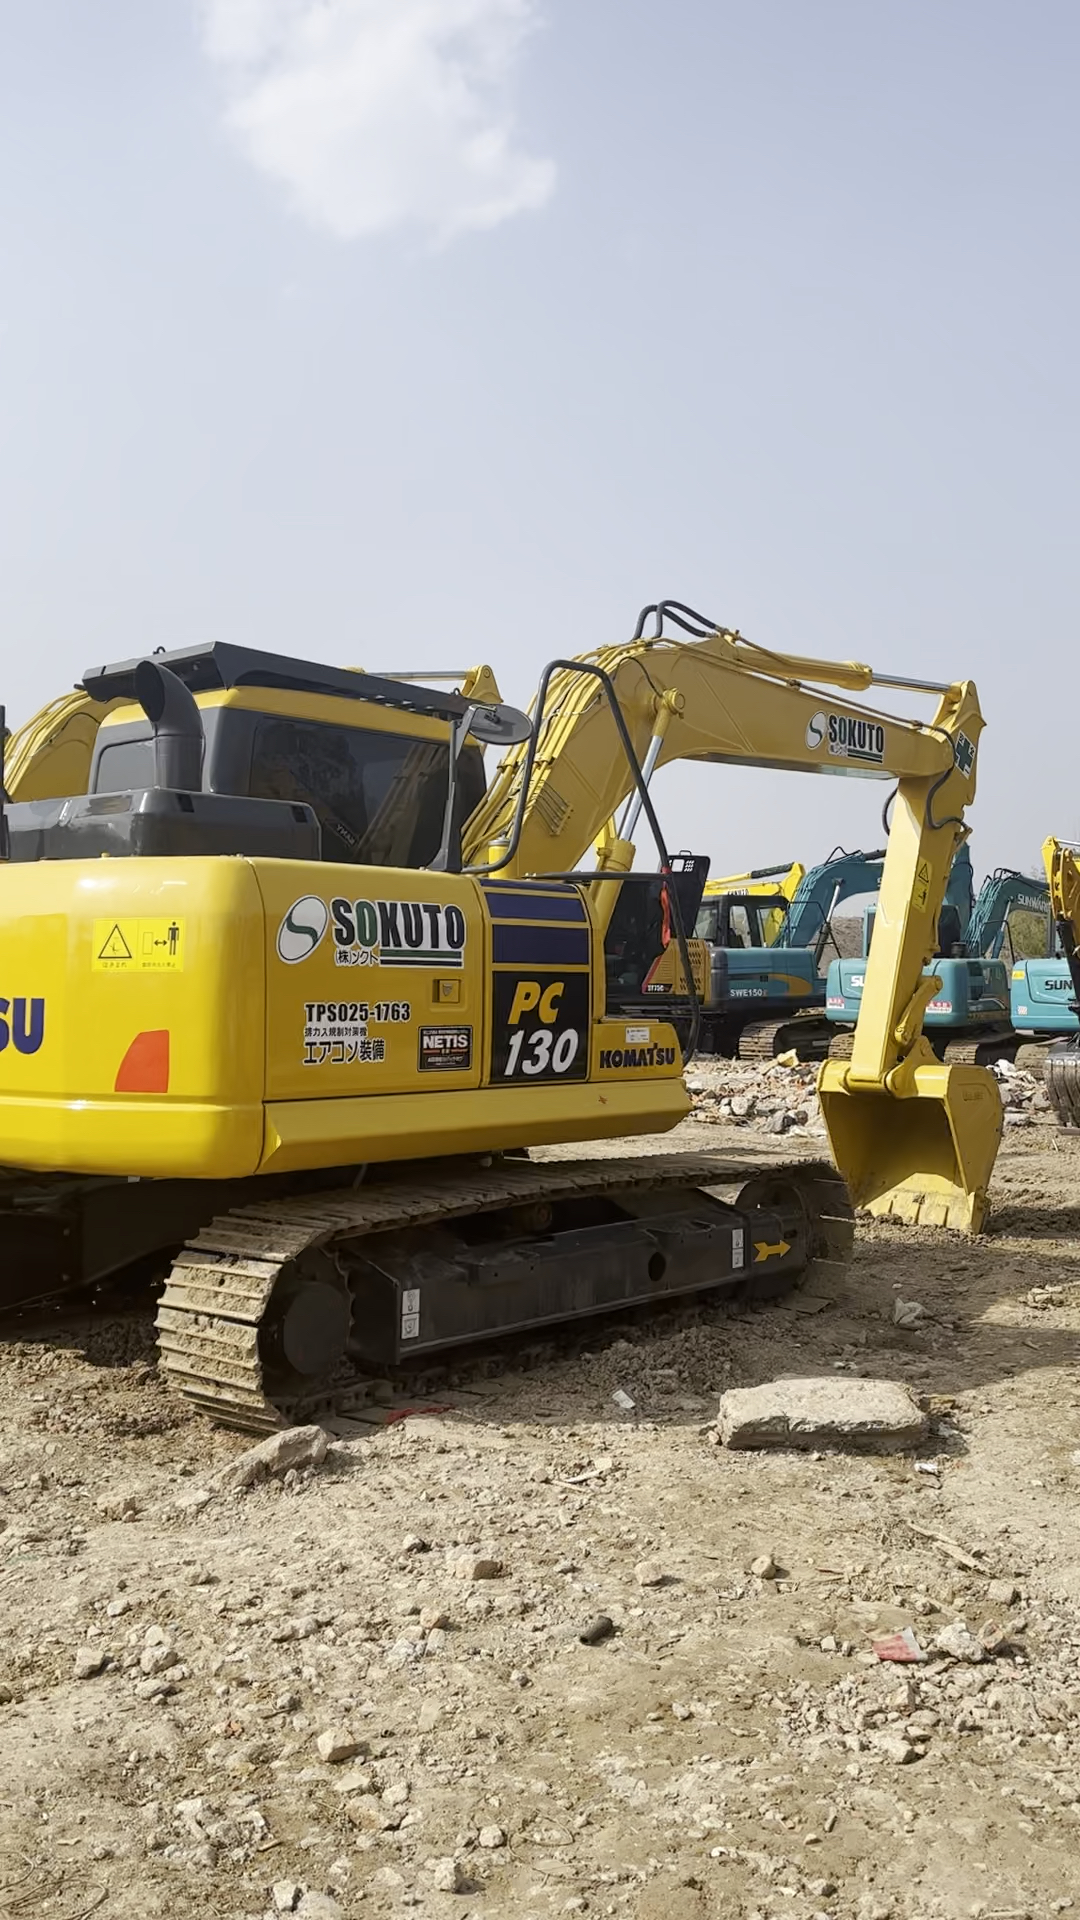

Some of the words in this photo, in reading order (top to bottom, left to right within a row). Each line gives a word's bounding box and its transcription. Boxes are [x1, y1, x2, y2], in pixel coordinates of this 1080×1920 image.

[829, 715, 884, 752] SOKUTO
[332, 900, 465, 949] SOKUTO
[305, 1003, 410, 1022] TPS025-1763
[507, 981, 565, 1024] PC
[423, 1034, 468, 1049] NETIS
[504, 1028, 579, 1076] 130
[599, 1043, 675, 1068] KOMATSU
